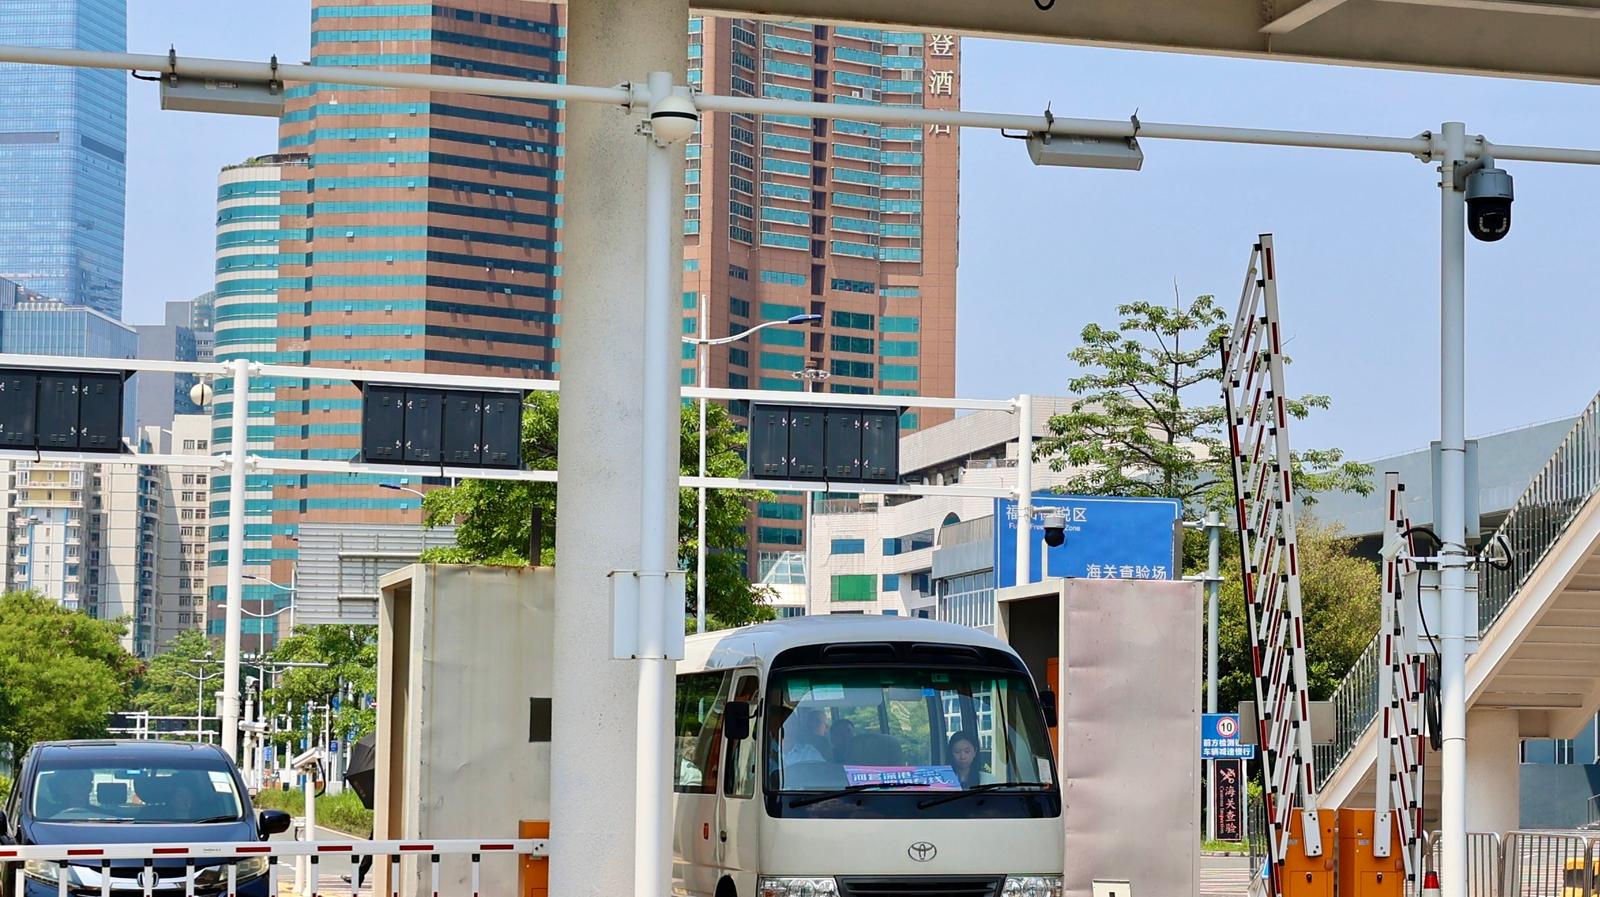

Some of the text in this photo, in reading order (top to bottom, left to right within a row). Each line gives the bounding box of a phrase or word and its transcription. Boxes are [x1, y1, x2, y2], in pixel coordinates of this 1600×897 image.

[1006, 504, 1088, 522] 福税区
[1086, 563, 1167, 580] 海关查验场
[1221, 722, 1233, 732] 10
[1203, 738, 1251, 748] 前方检测
[1203, 747, 1251, 757] 车辆减速慢行
[1225, 785, 1237, 834] 海关查验
